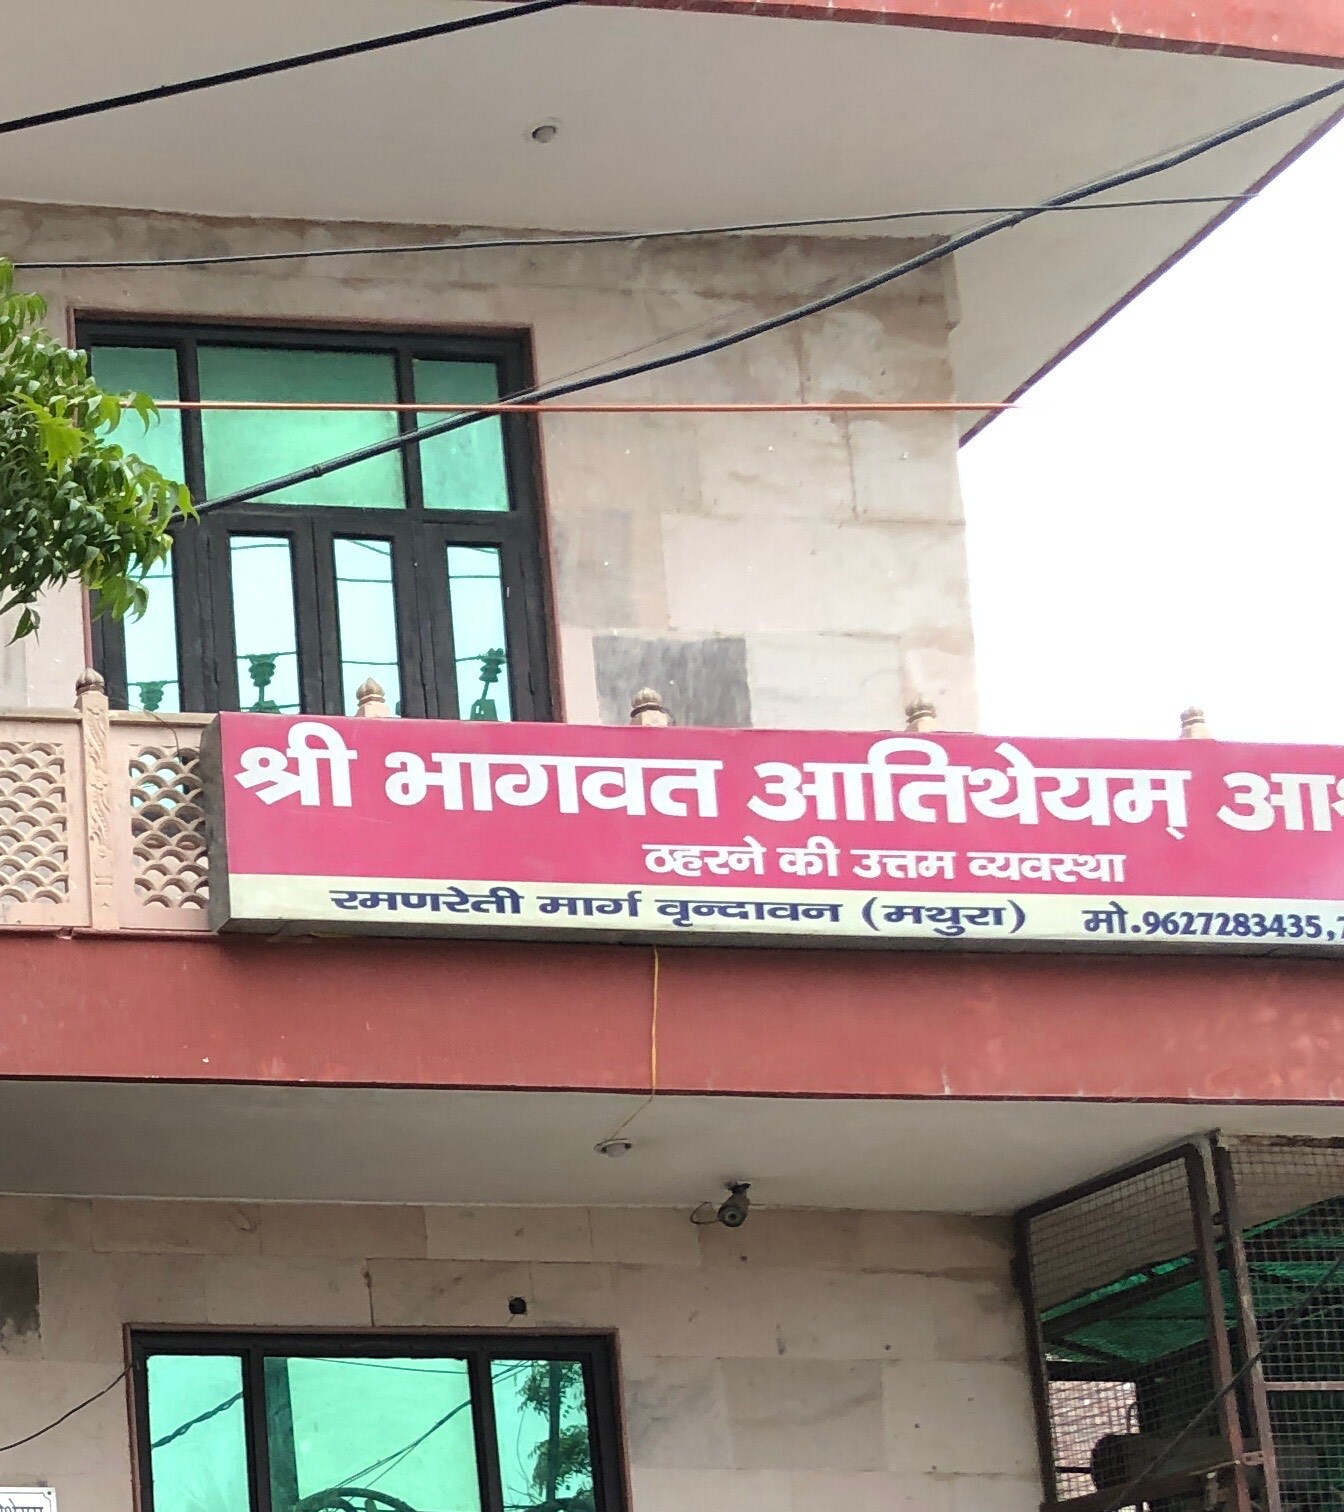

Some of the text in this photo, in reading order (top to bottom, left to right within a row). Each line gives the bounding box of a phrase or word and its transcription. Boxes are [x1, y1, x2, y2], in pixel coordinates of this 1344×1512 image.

[233, 721, 358, 808] श्री
[384, 748, 724, 818] भागवत
[747, 737, 1192, 840] आतिथेयम्
[641, 835, 1127, 883] ठहरने की उत्तम व्यवस्था
[328, 885, 525, 916] रमणरेती
[536, 889, 645, 919] मार्ग
[655, 899, 843, 926] वृन्दावन
[861, 896, 1027, 937] (मथुरा)
